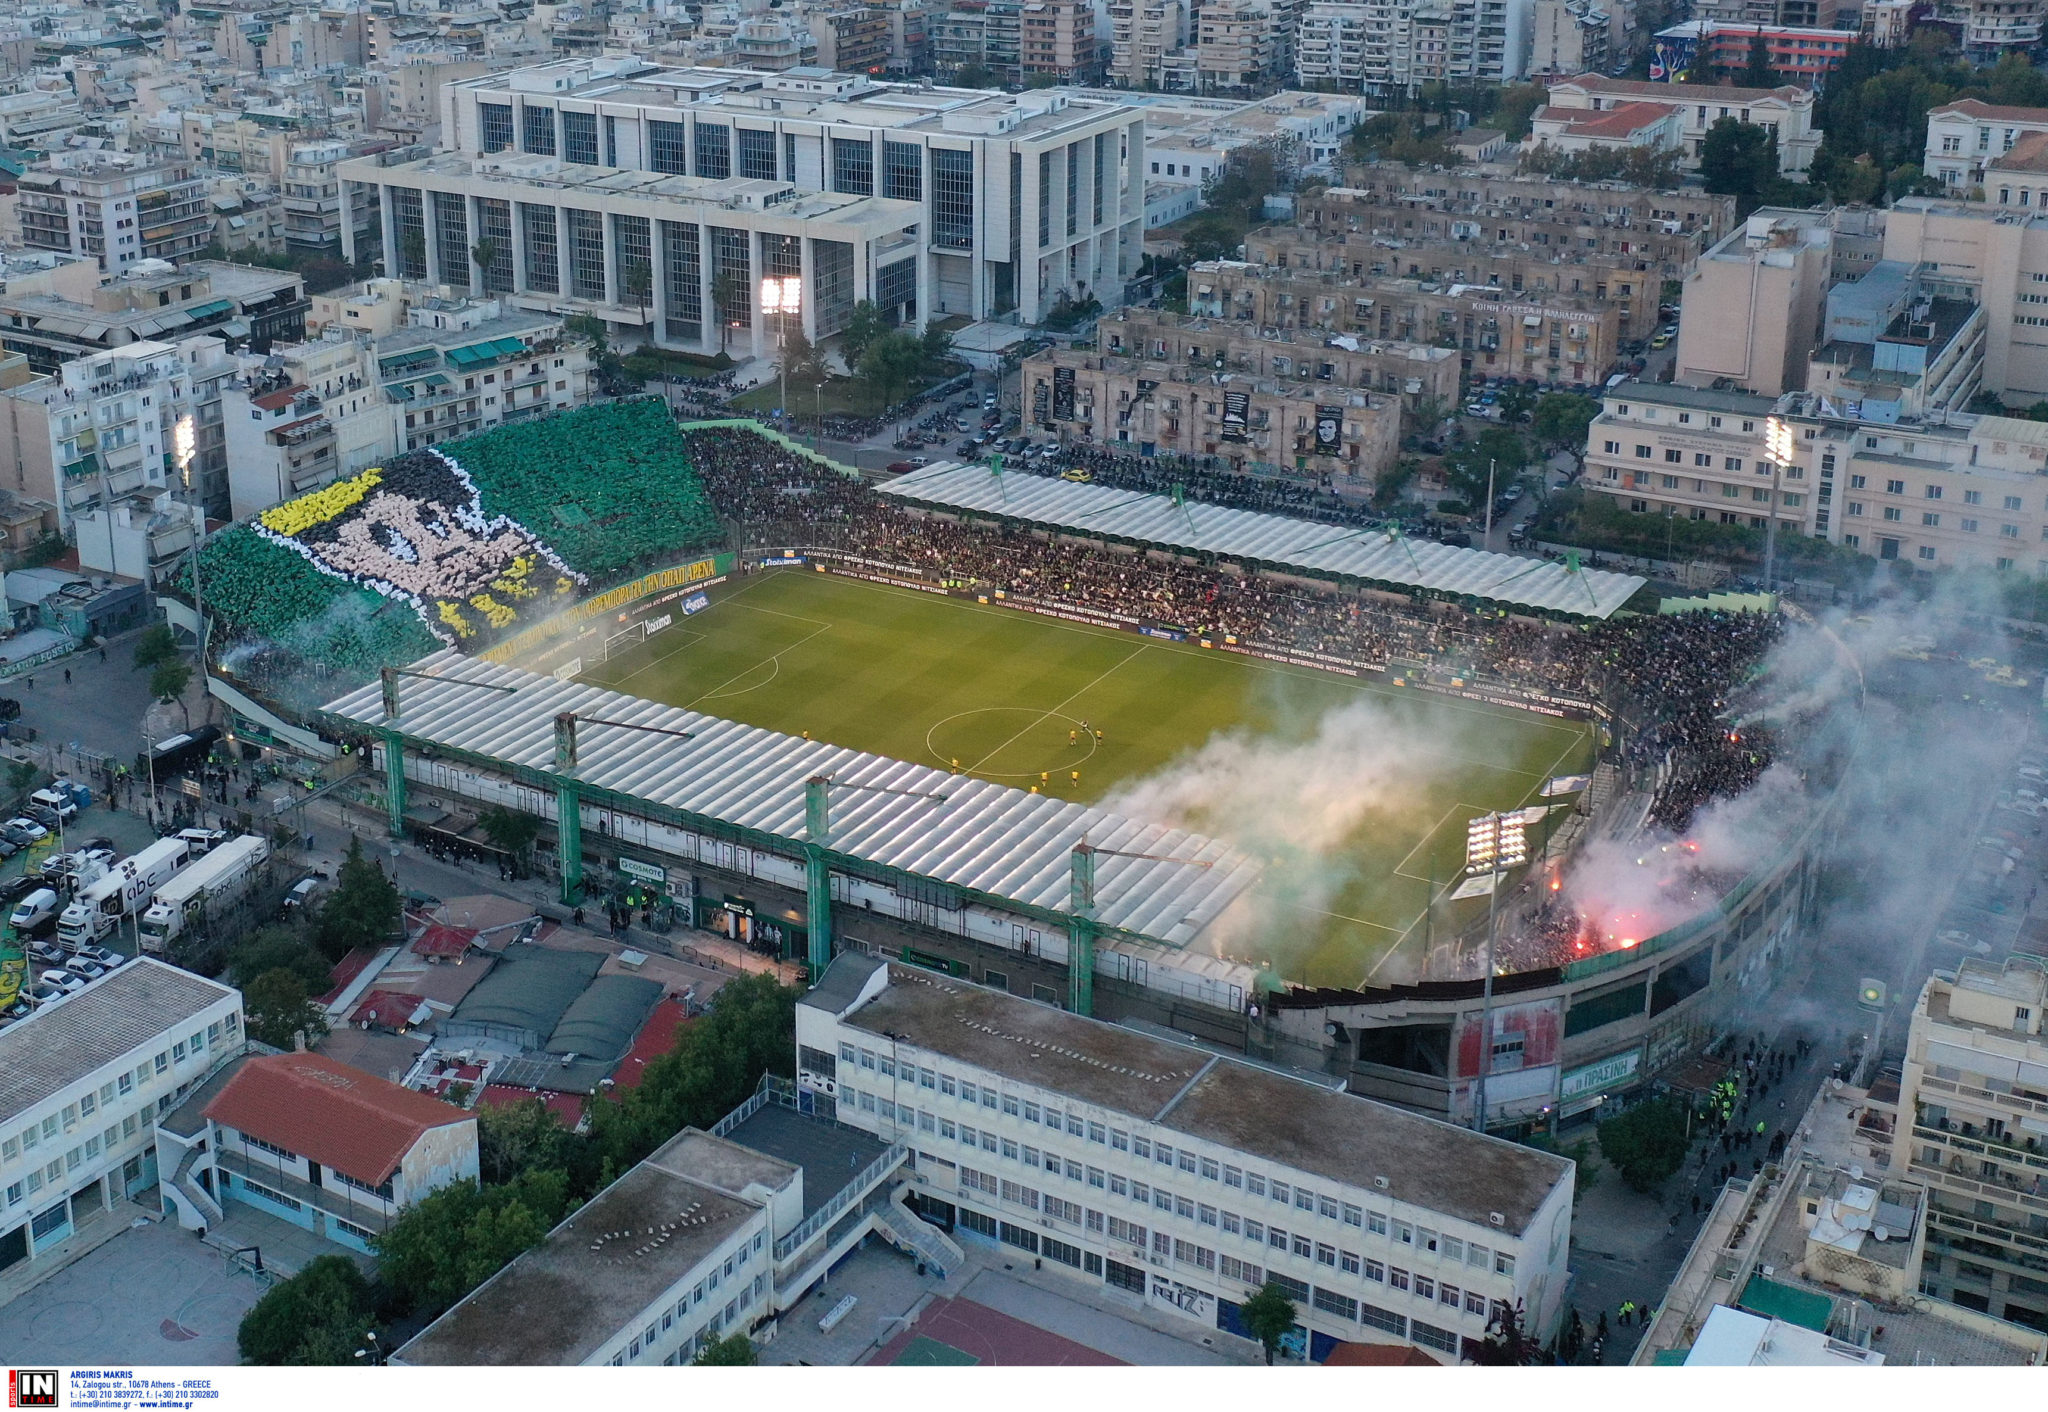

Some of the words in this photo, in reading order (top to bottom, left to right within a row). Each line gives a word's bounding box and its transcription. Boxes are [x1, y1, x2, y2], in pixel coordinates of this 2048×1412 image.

[803, 551, 831, 559] ΑΛΛΑΝΤΙΚΑ
[644, 573, 660, 594] ΤΗΝ
[661, 565, 686, 588] ΟΠΑΠ
[832, 568, 858, 578] ΑΛΛΑΝΤΙΚΑ
[859, 572, 868, 580] ΑΠΟ
[995, 600, 1022, 611] ΑΛΛΑΝΤΙΚΑ
[1024, 605, 1034, 613] ΑΠΟ
[1058, 612, 1090, 624] ΚΟΤΟΠΟΥΛΟ
[1091, 618, 1120, 630] ΝΙΤΣΙΑΚΟΣ
[1013, 594, 1040, 605] ΑΛΛΑΝΤΙΚΑ
[1041, 599, 1052, 607] ΑΠΟ
[1077, 607, 1109, 619] ΚΟΤΟΠΟΥΛΟ
[1110, 613, 1140, 624] ΝΙΤΣΙΑΚΟΣ
[1219, 644, 1250, 656] ΑΛΛΑΝΤΙΚΑ
[1251, 650, 1263, 658] ΑΠΟ
[1289, 658, 1324, 670] ΚΟΤΟΠΟΥΛΟ
[1325, 664, 1358, 677] ΝΙΤΣΙΑΚΟΣ
[1245, 640, 1276, 651] ΑΛΛΑΝΤΙΚΑ
[1277, 645, 1289, 654] ΑΠΟ
[1316, 654, 1351, 666] ΚΟΤΟΠΟΥΛΟ
[1353, 660, 1386, 673] ΝΙΤΣΙΑΚΟΣ
[1490, 697, 1528, 710] ΚΟΤΟΠΟΥΛΟ
[1529, 704, 1564, 718] ΝΙΤΣΙΑΚΟΣ
[1551, 695, 1591, 710] ΚΟΤΟΠΟΥΛΟ
[628, 862, 662, 877] COSMOTE
[126, 872, 157, 900] abc
[1584, 1059, 1628, 1088] ΠΡΑΣΙΝΗ
